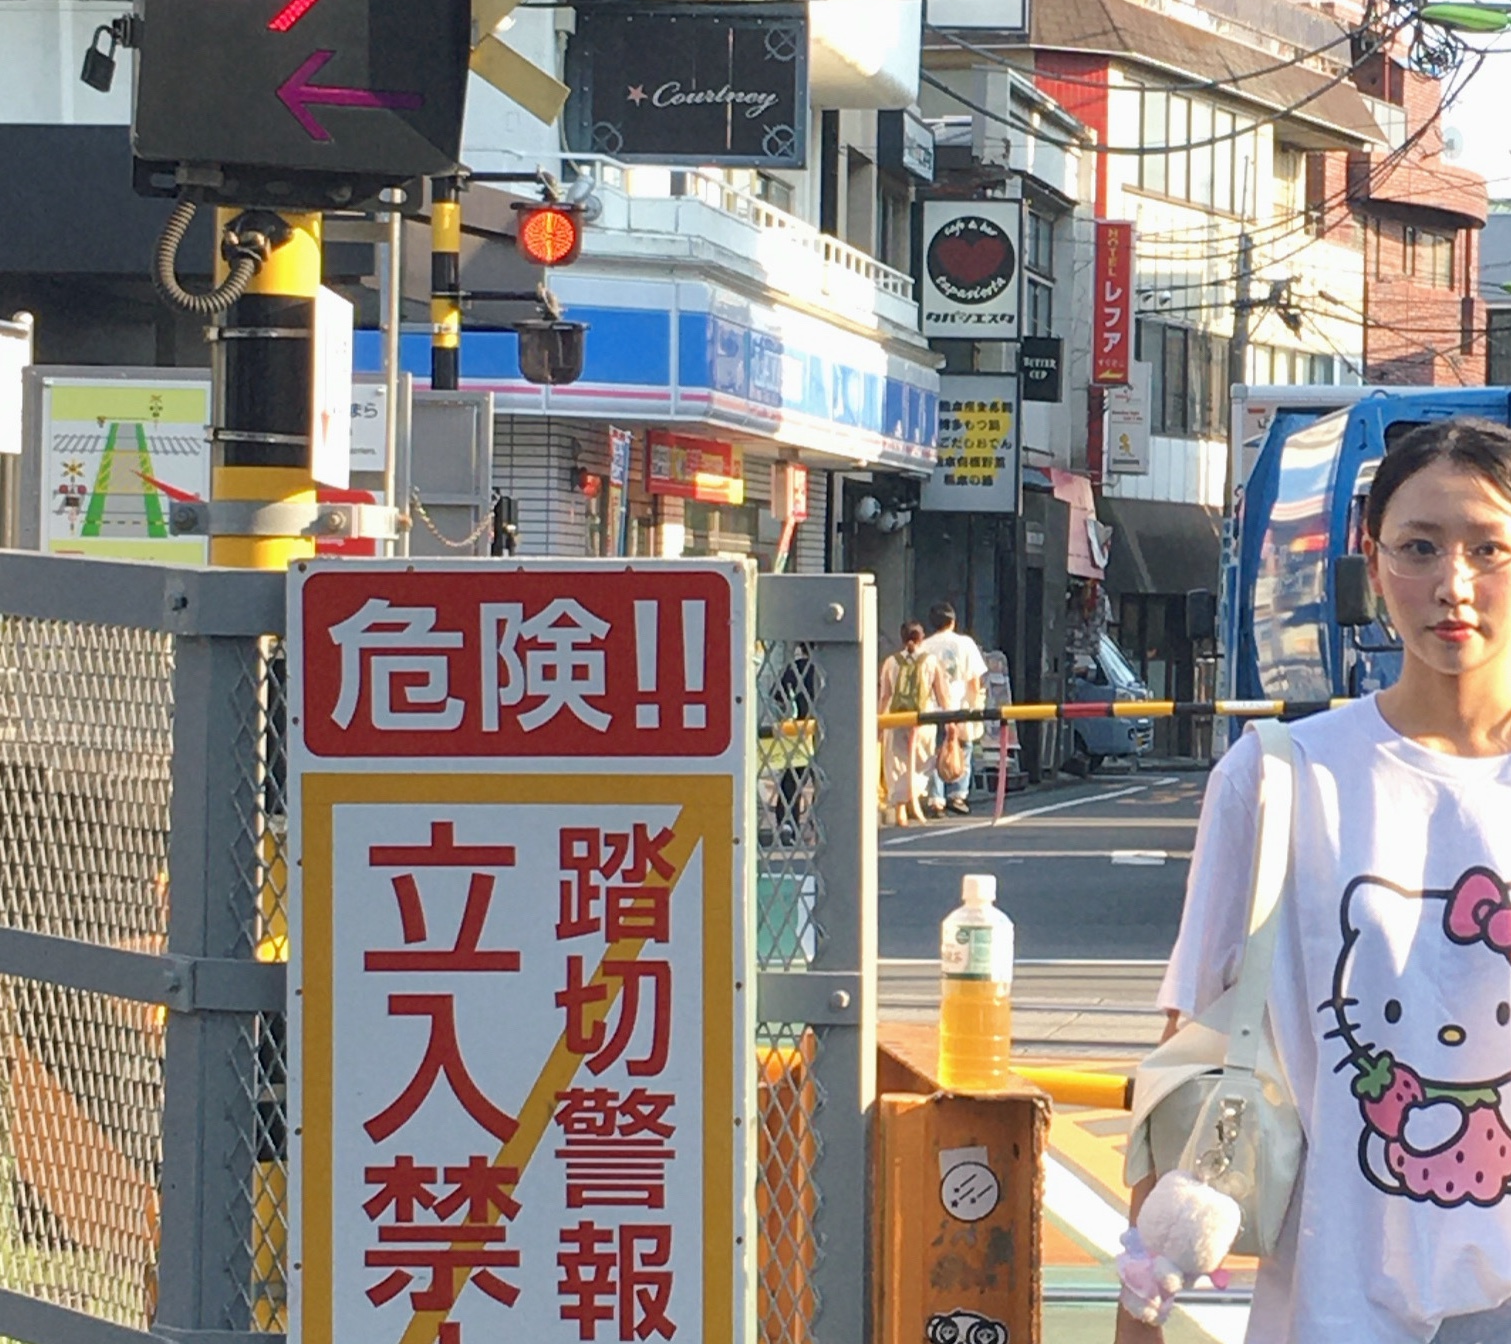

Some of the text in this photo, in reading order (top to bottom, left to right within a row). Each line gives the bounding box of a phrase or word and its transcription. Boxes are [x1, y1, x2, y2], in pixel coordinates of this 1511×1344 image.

[1103, 281, 1123, 353] レフア
[328, 597, 707, 733] 危険!!
